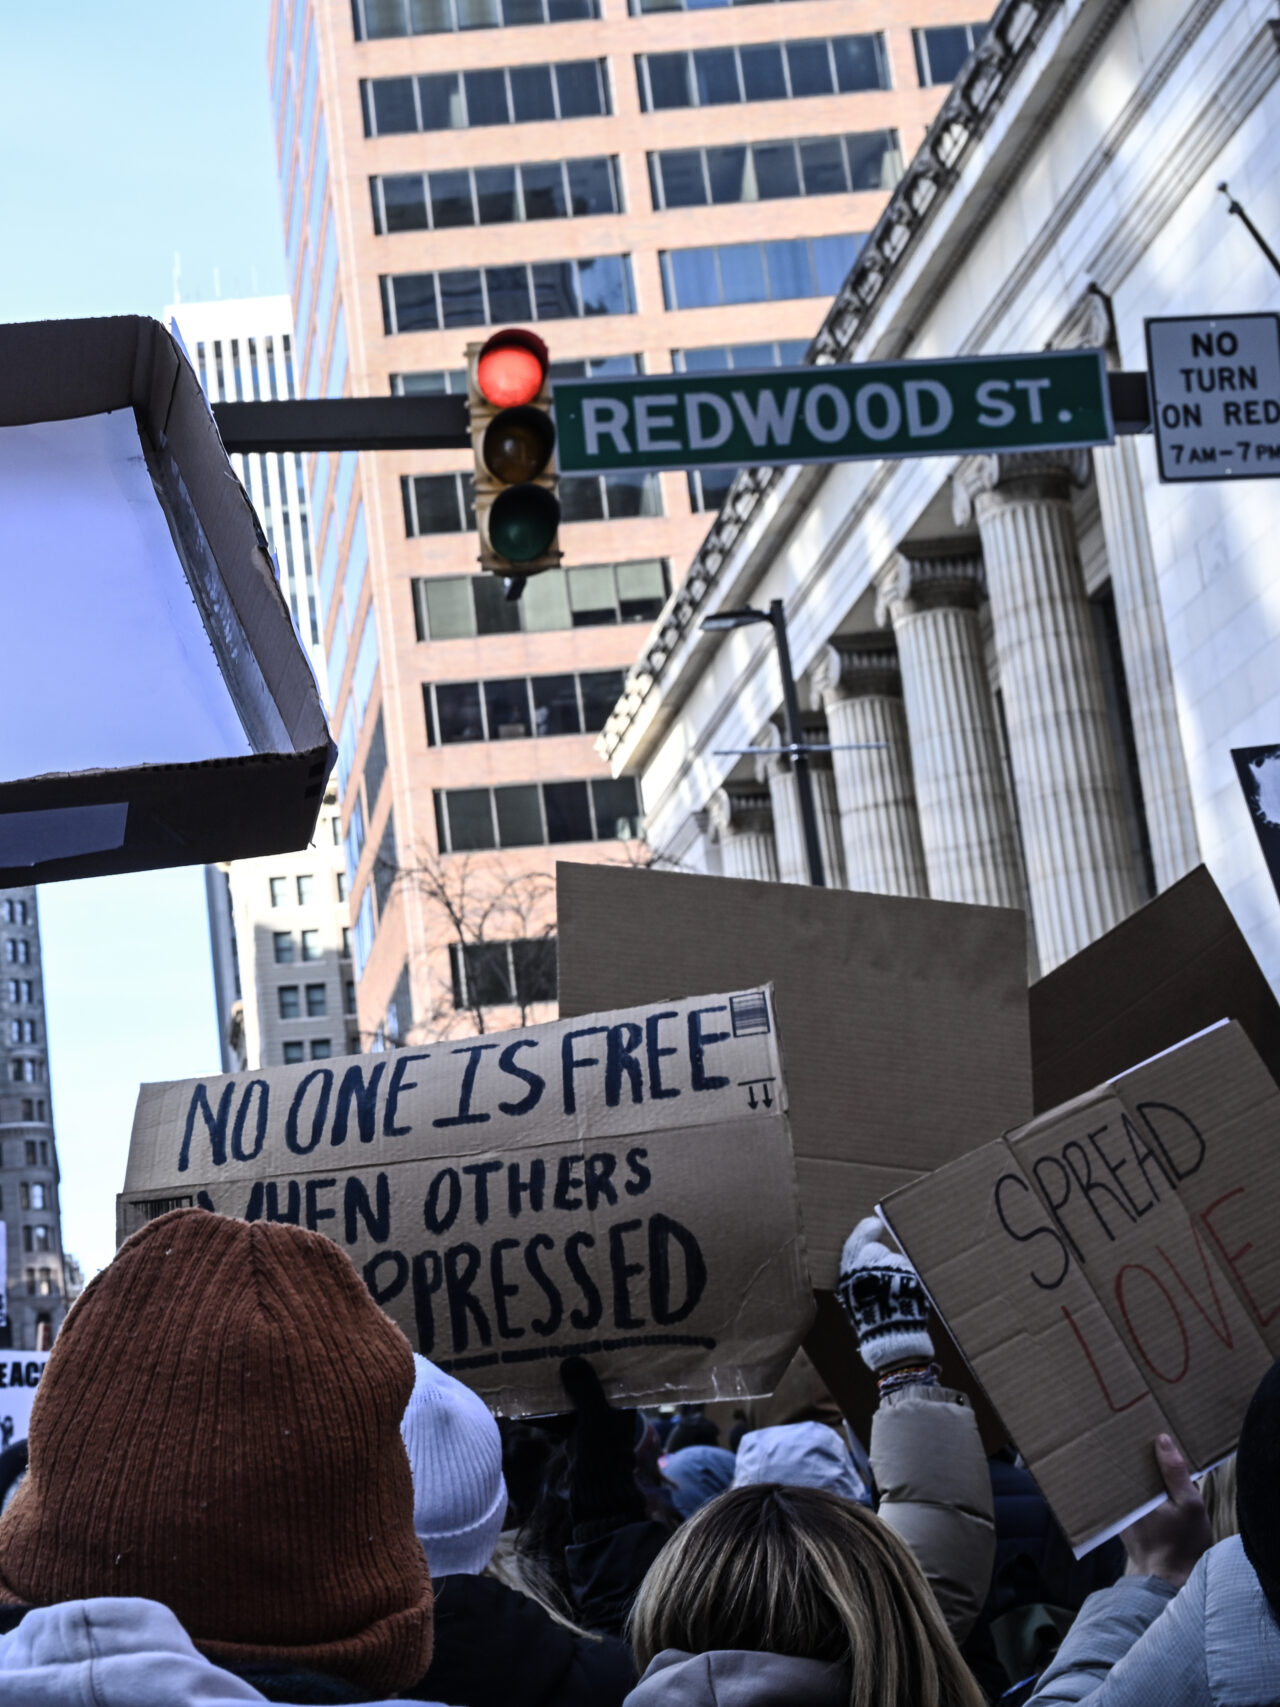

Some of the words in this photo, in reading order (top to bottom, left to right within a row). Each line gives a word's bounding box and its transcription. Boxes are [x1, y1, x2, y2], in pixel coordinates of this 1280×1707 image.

[1180, 365, 1258, 393] TURN
[1191, 331, 1238, 358] NO
[581, 378, 954, 456] REDWOOD
[975, 377, 1074, 429] ST.
[1162, 403, 1202, 429] ON
[1223, 399, 1280, 426] RED
[177, 1079, 269, 1172] NO
[284, 1052, 431, 1156] ONE
[432, 1039, 546, 1129] IS
[561, 1005, 730, 1115] FREE
[423, 1147, 652, 1234] OTHERS
[995, 1102, 1206, 1290] SPREAD
[363, 1212, 708, 1355] PPRESSED
[1061, 1187, 1280, 1413] LOVE
